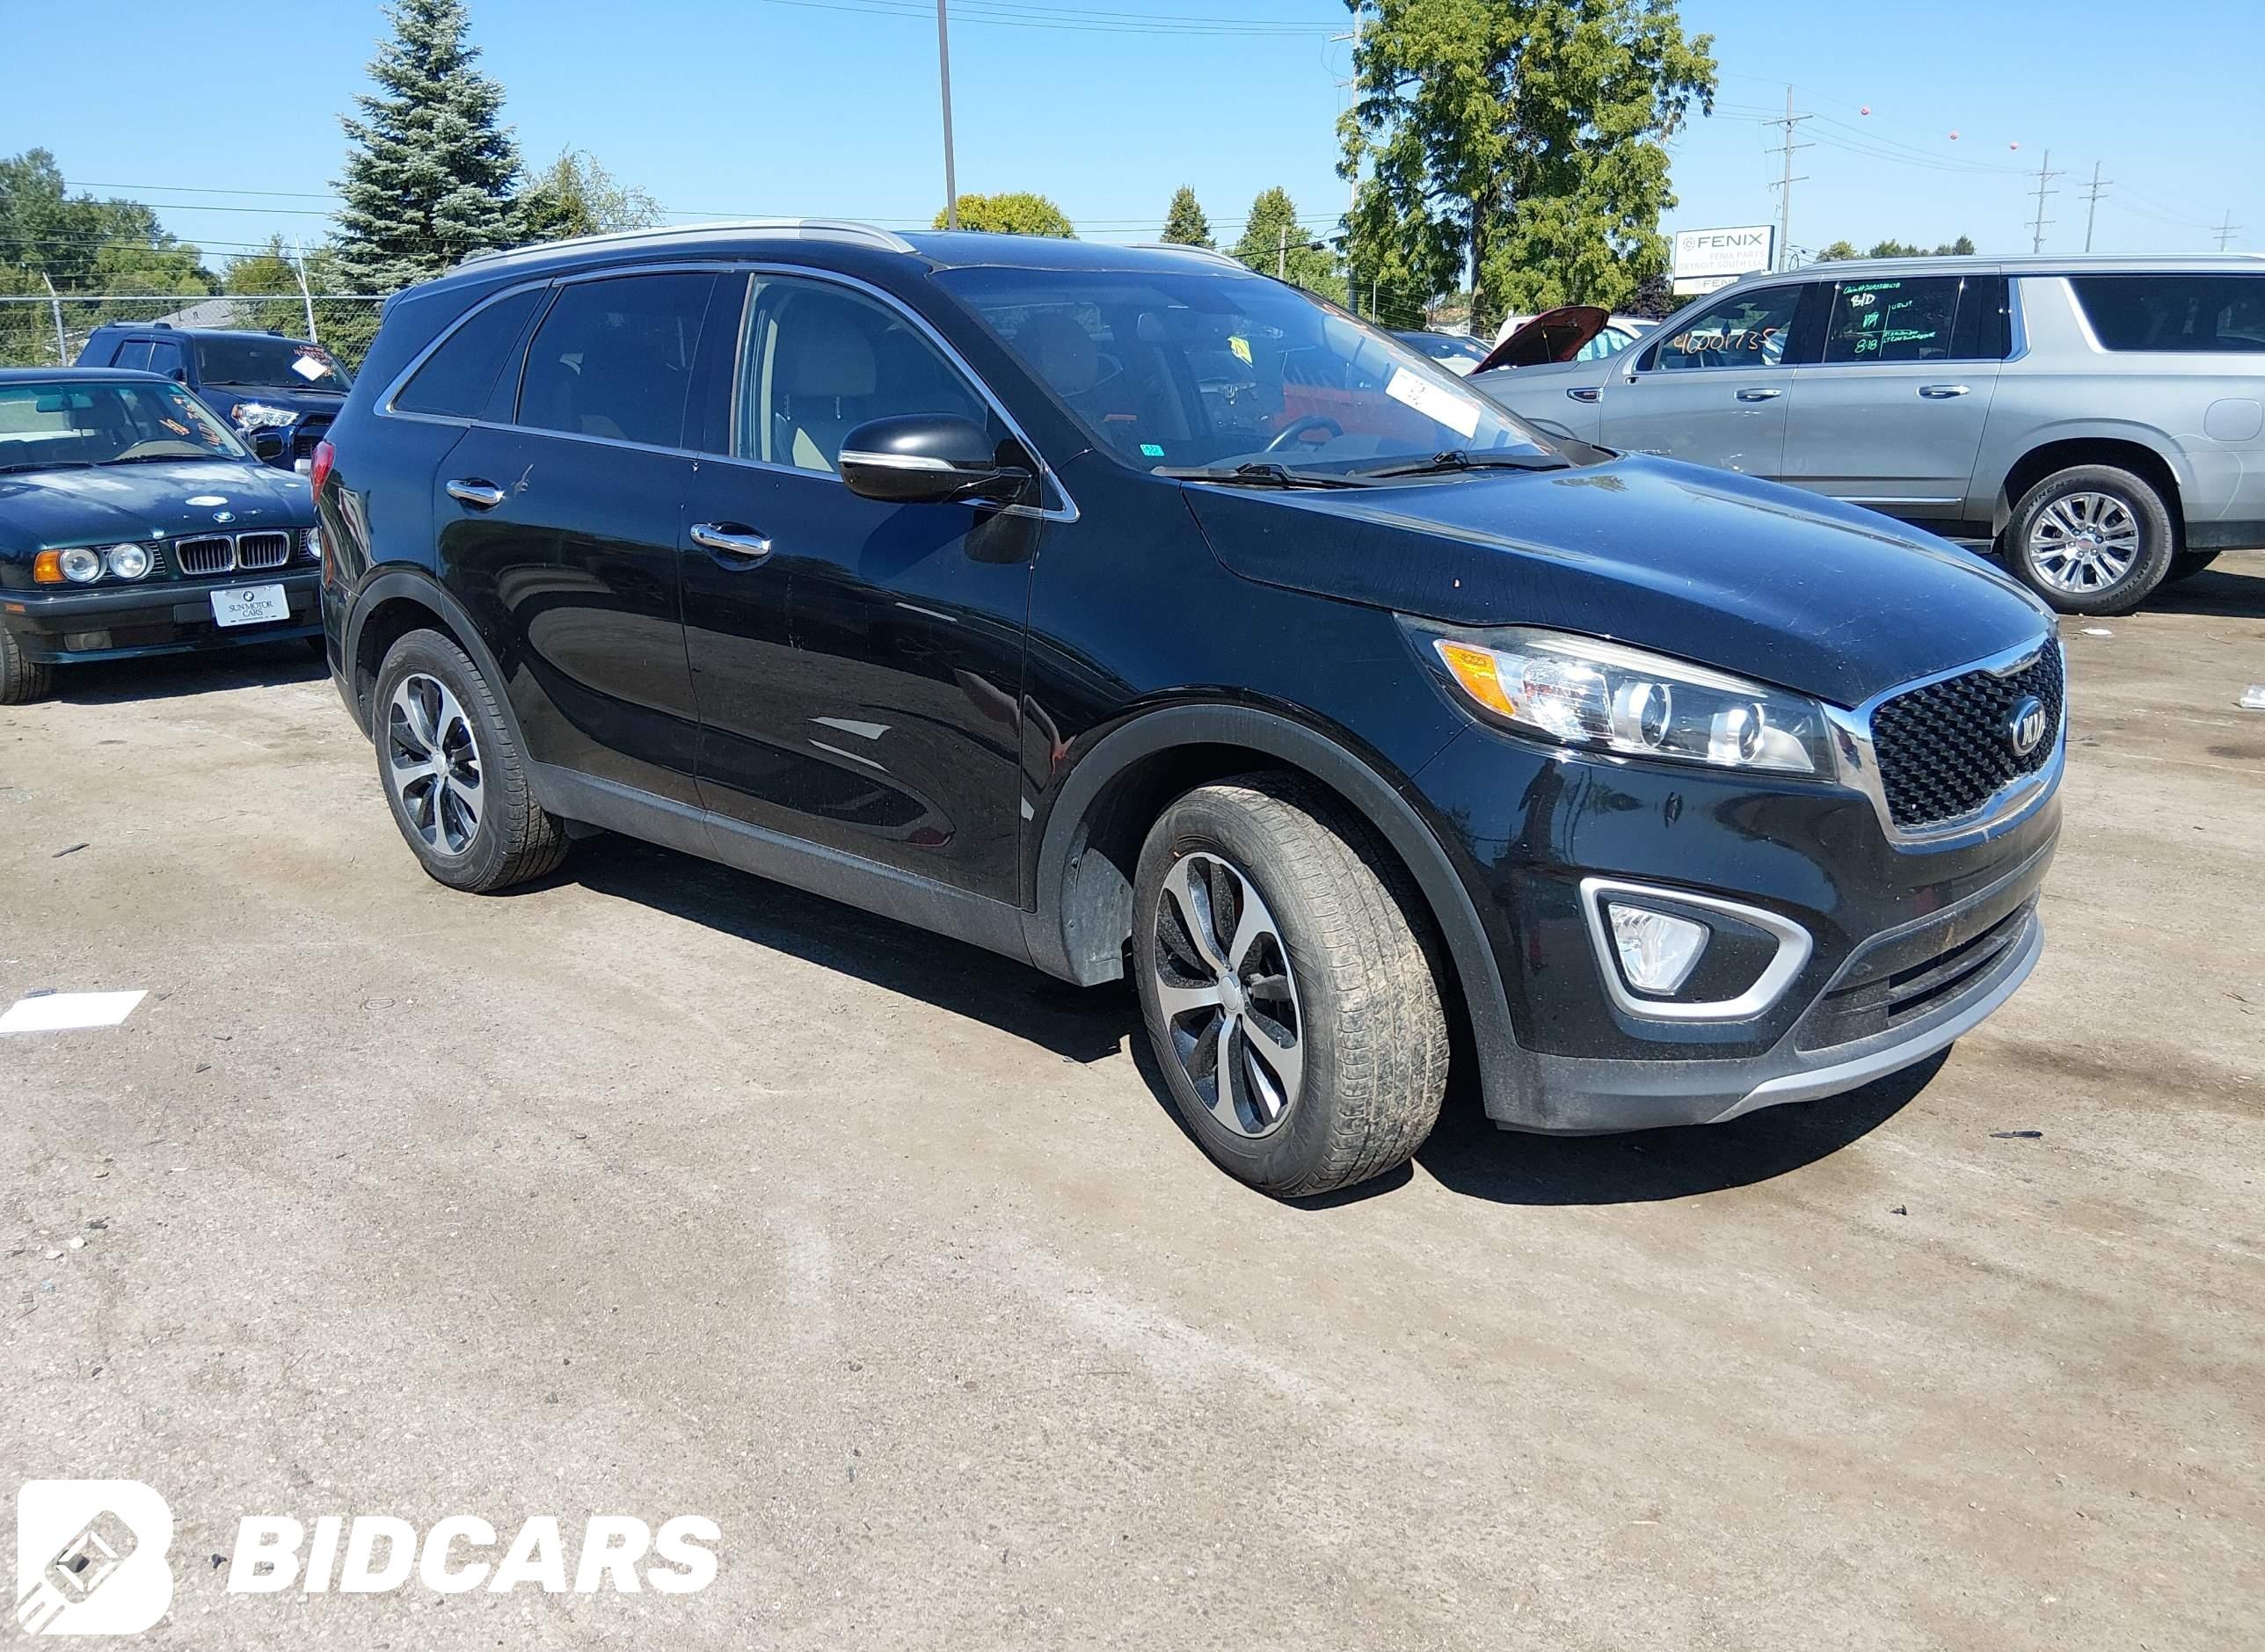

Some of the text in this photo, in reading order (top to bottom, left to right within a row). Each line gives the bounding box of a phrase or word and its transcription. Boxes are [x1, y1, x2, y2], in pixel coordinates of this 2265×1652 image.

[1697, 233, 1764, 249] FENIX
[1709, 250, 1766, 260] FENIX PARTS
[1679, 261, 1715, 272] DETROIT
[1717, 259, 1746, 268] SOUTH
[1703, 278, 1736, 288] FENI
[229, 600, 273, 613] SUN MOTOR
[242, 608, 264, 617] CARS
[2021, 710, 2045, 746] KIA
